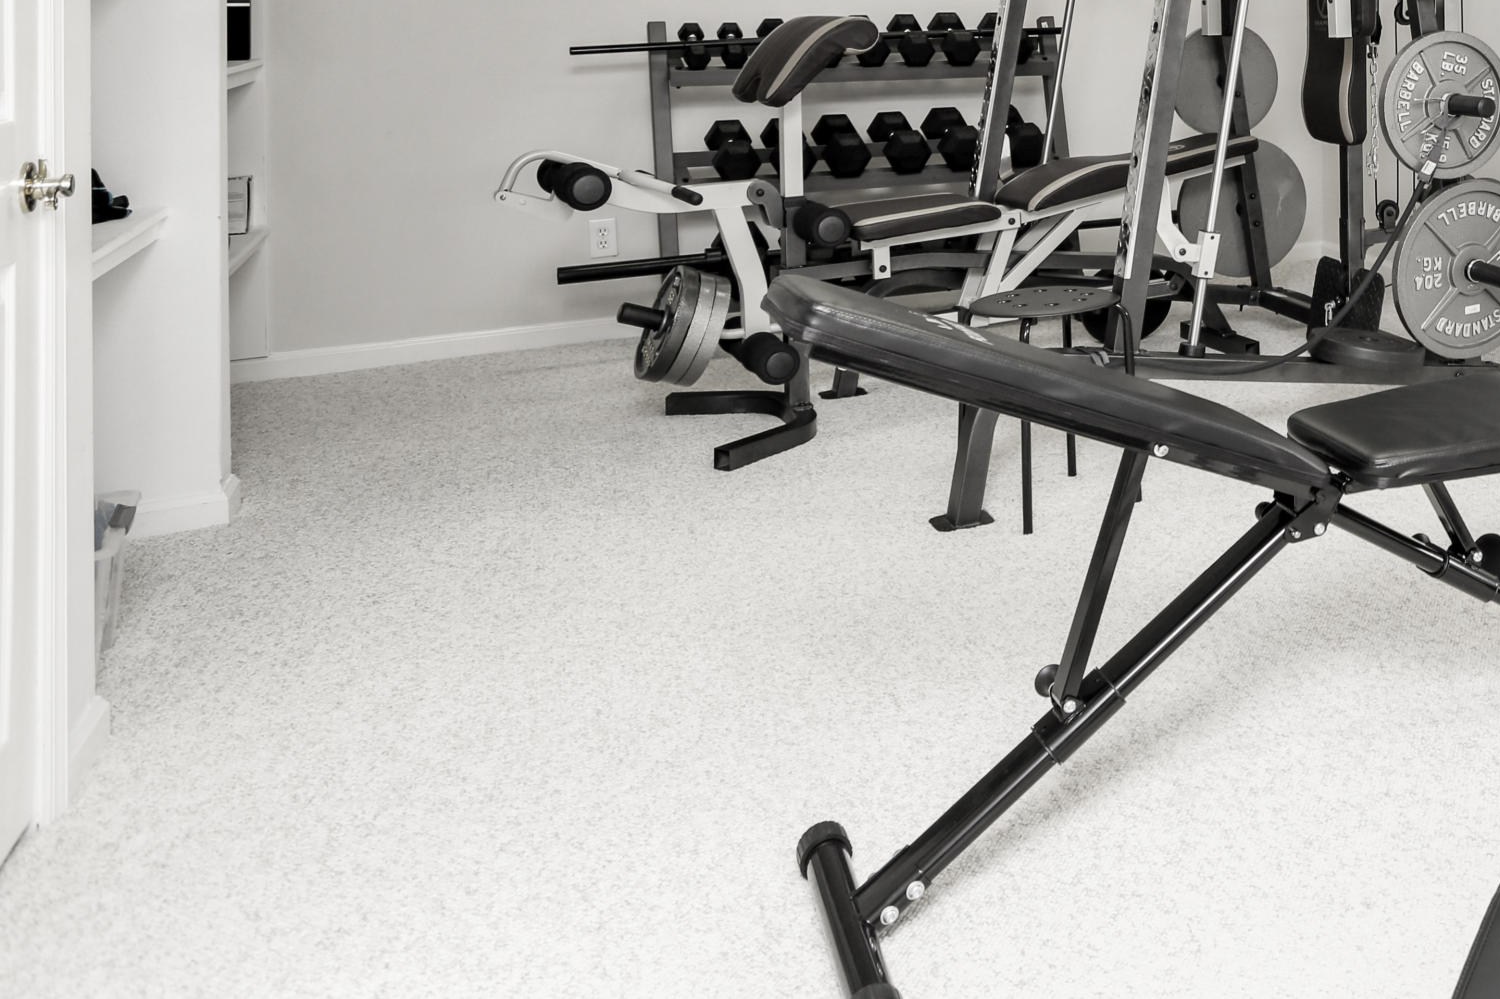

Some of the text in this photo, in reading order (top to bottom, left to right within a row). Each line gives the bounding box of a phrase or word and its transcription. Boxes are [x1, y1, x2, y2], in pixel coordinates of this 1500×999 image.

[1454, 54, 1468, 75] 35
[1398, 61, 1424, 132] BARBELL
[1415, 273, 1442, 291] 20.4
